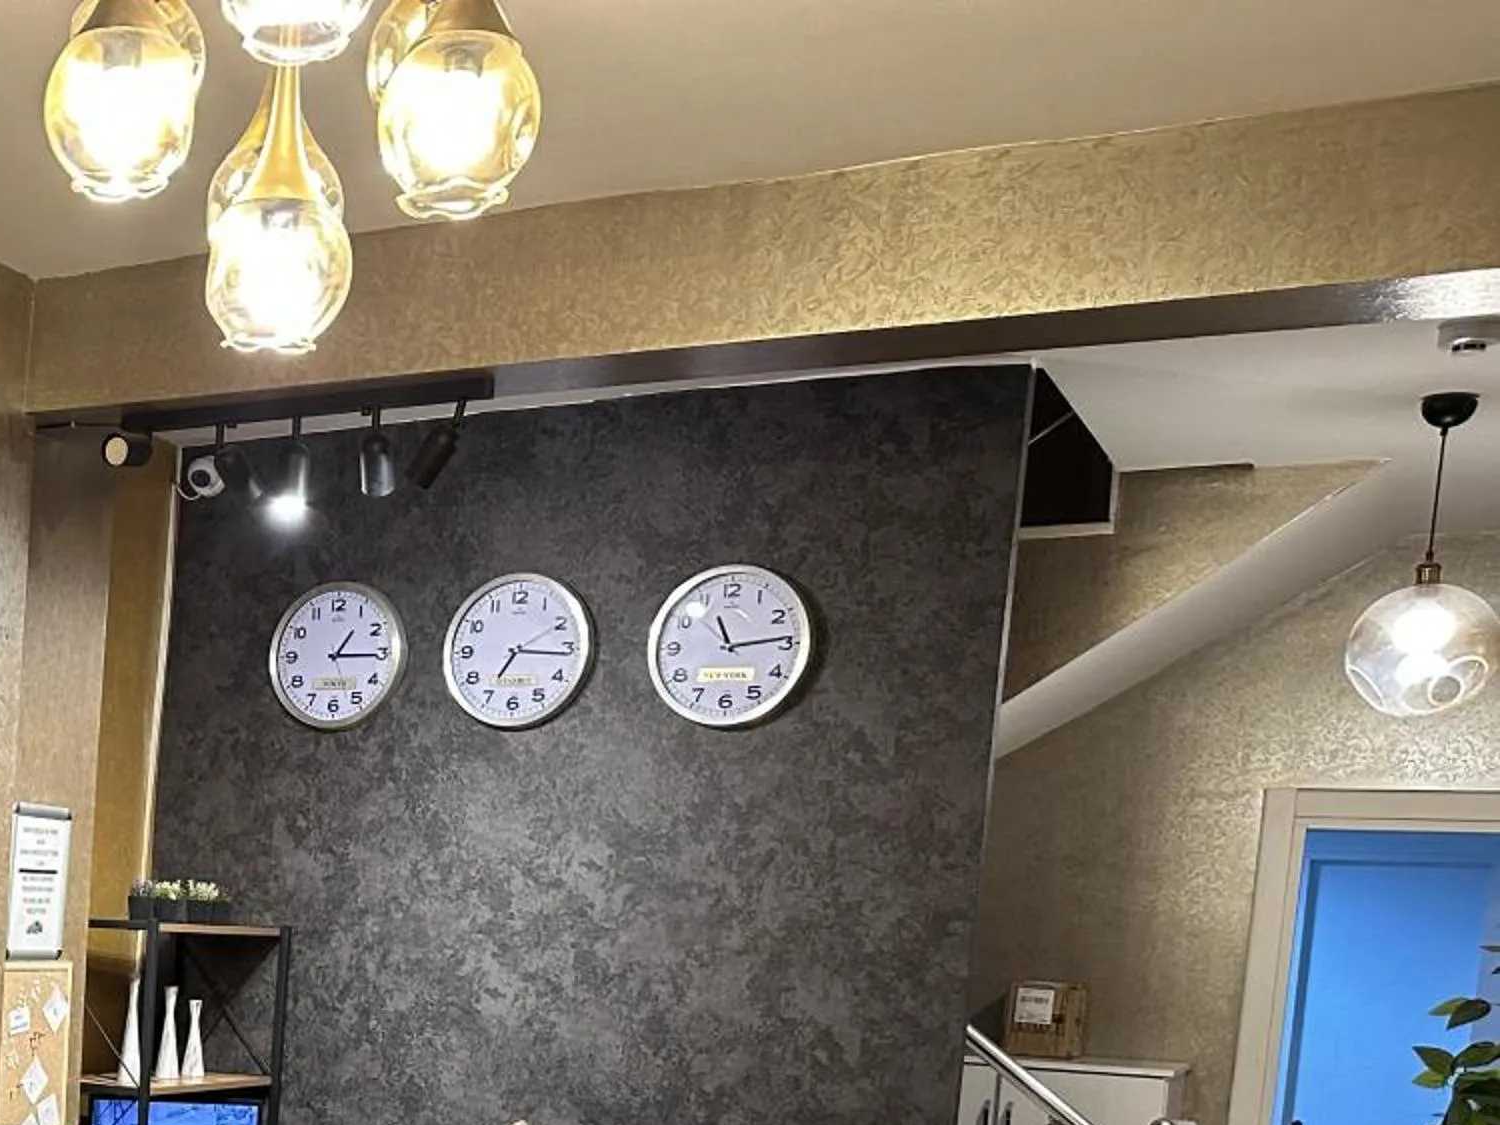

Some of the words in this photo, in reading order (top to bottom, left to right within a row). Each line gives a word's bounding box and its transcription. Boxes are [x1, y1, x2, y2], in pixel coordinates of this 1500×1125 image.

[512, 591, 529, 604] 12
[723, 583, 741, 598] 12
[331, 598, 346, 612] 12
[490, 599, 500, 613] 11
[312, 607, 320, 620] 11
[771, 609, 786, 624] 2
[369, 623, 382, 636] 2
[470, 620, 484, 633] 10
[554, 616, 567, 630] 2
[678, 616, 691, 629] 10
[293, 627, 306, 639] 10
[563, 641, 575, 655] 3
[667, 641, 681, 656] 9
[778, 636, 793, 651] 3
[286, 651, 298, 664] 9
[376, 647, 388, 661] 3
[461, 645, 474, 658] 9
[551, 668, 564, 682] 4
[672, 668, 688, 682] 8
[768, 663, 782, 678] 4
[291, 675, 304, 688] 8
[367, 673, 378, 685] 4
[466, 671, 479, 685] 8
[307, 693, 317, 706] 7
[351, 691, 363, 704] 5
[483, 689, 495, 704] 7
[532, 688, 545, 702] 5
[692, 688, 705, 702] 7
[746, 685, 761, 700] 5
[327, 699, 339, 712] 6
[506, 696, 519, 710] 6
[718, 694, 733, 709] 6
